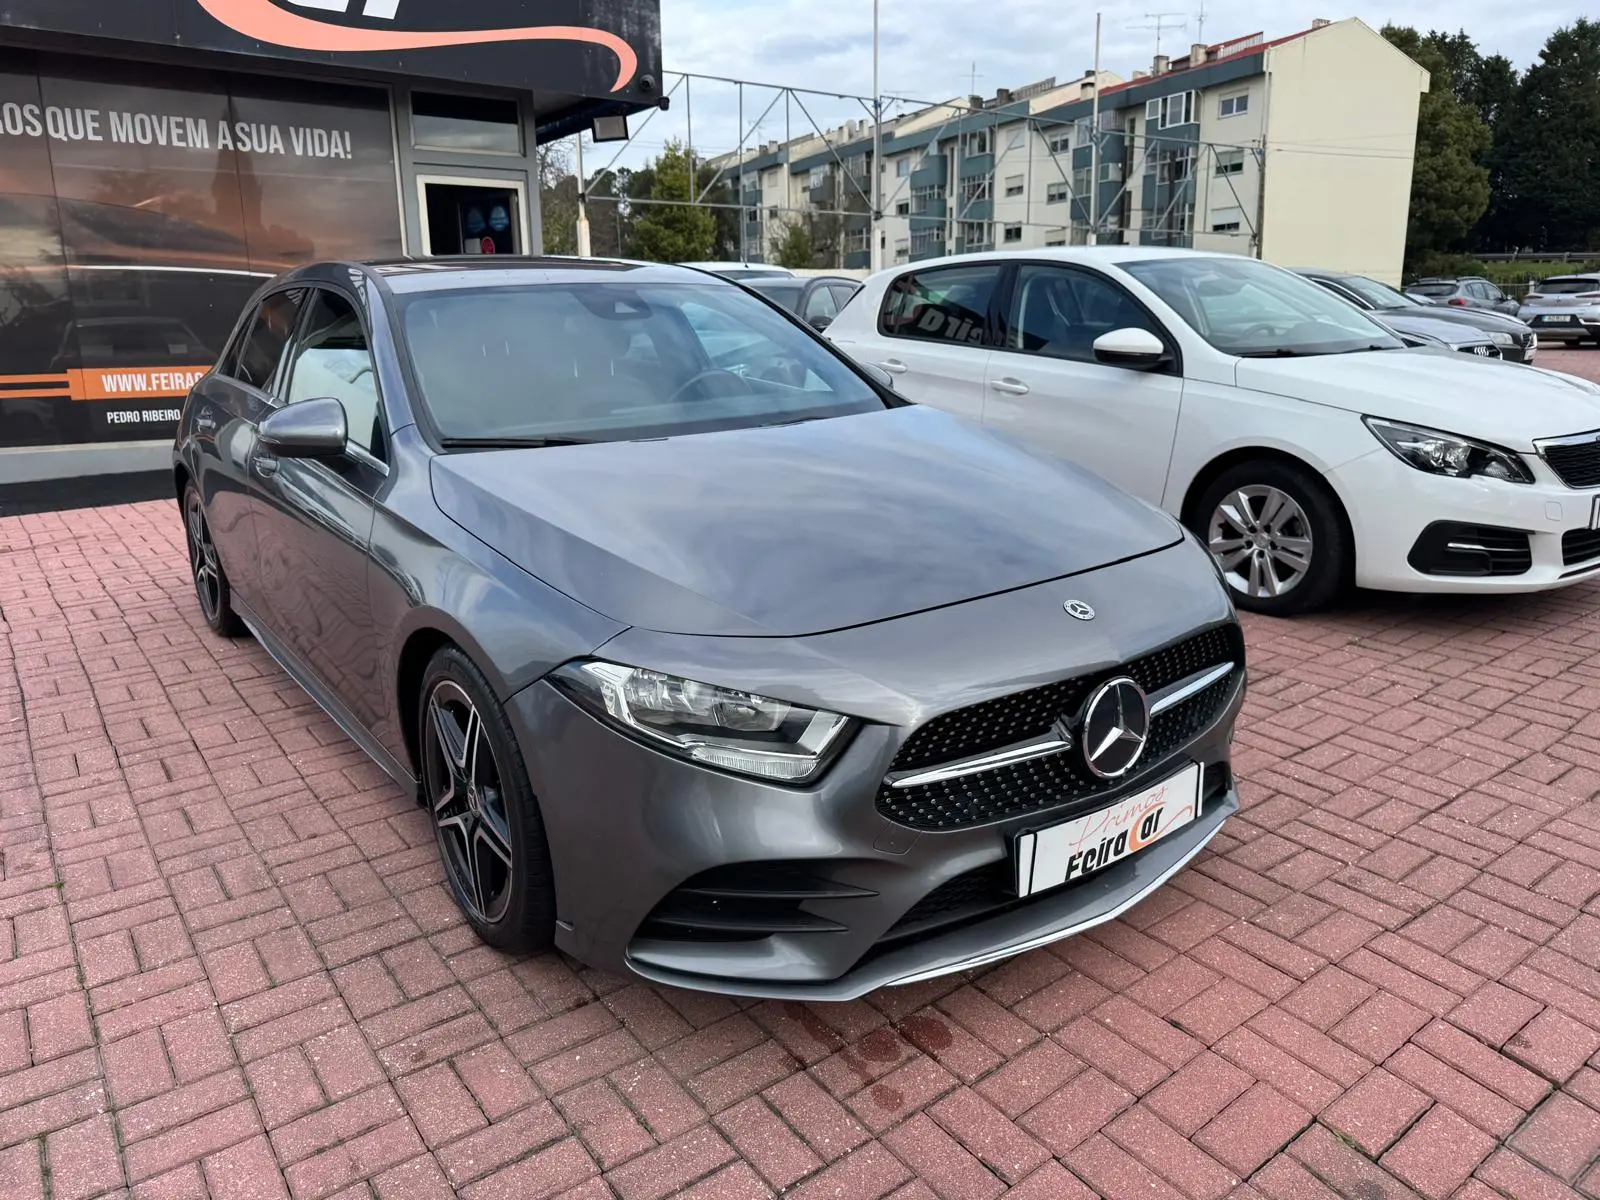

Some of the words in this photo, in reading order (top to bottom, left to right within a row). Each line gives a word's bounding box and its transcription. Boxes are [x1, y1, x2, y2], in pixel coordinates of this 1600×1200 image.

[45, 106, 103, 142] QUE
[108, 111, 209, 149] MOVEM
[289, 126, 352, 159] VIDA!
[106, 410, 140, 424] PEDRO
[142, 408, 181, 422] RIBEIRO
